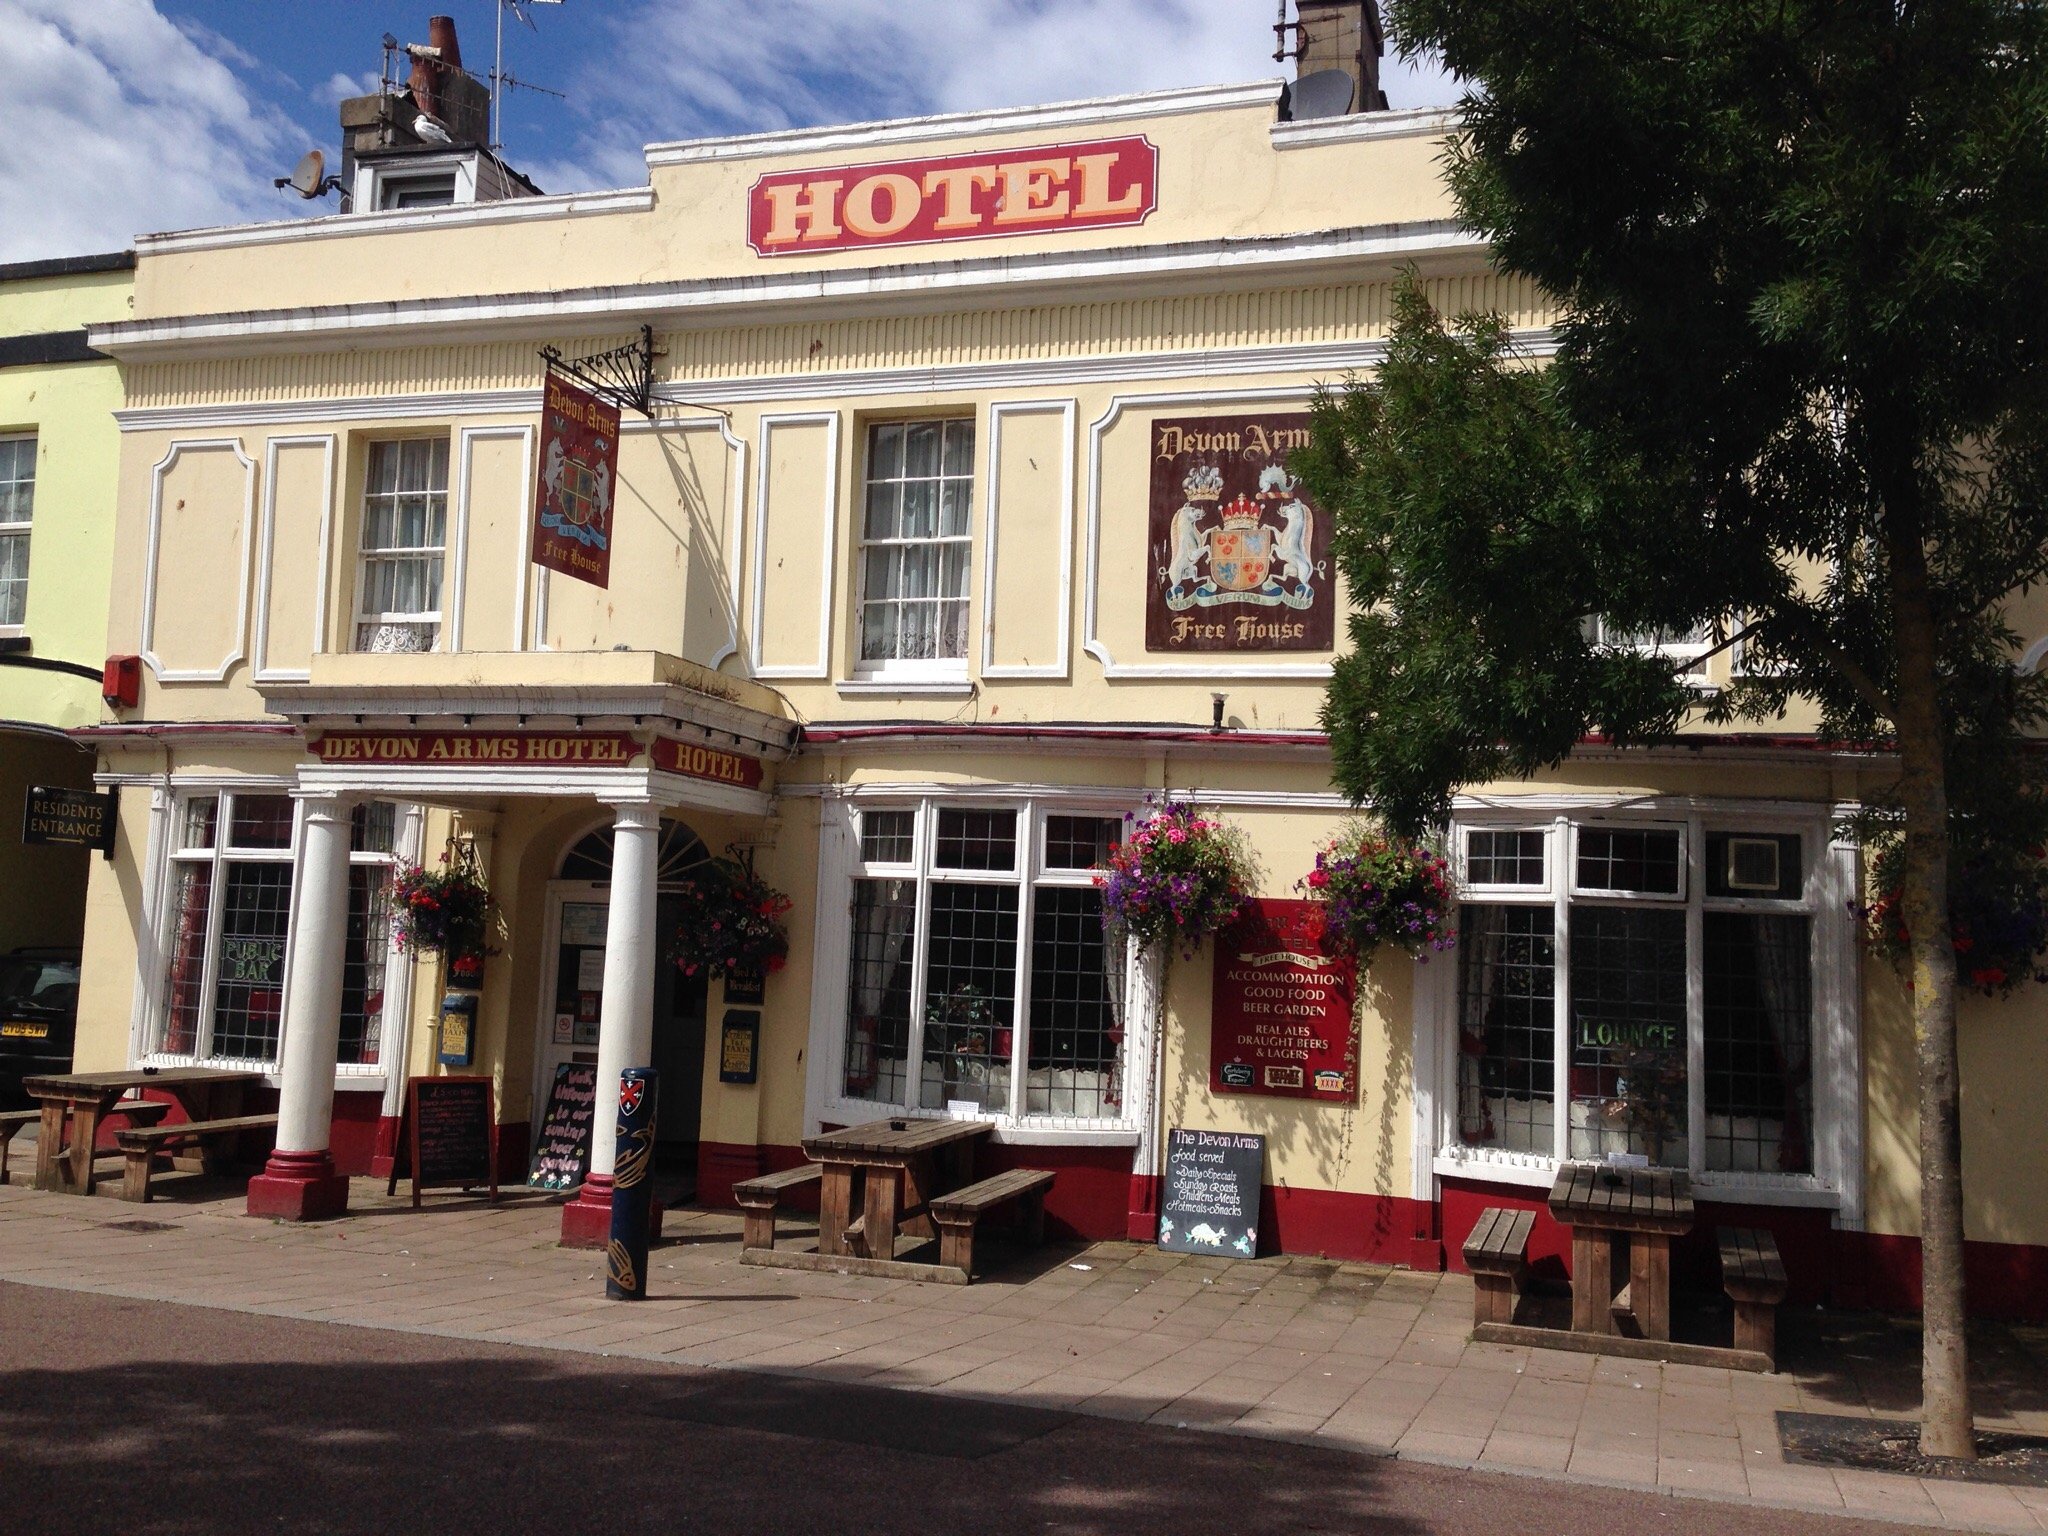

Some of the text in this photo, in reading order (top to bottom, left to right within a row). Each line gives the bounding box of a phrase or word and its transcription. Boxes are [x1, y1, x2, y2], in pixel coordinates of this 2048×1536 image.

[763, 153, 1142, 245] HOTEL
[549, 383, 616, 438] Devon Arms
[1156, 424, 1315, 461] Devon Arm
[542, 540, 602, 573] Free House
[1216, 593, 1261, 604] VERUM
[1170, 615, 1305, 643] Free House
[323, 738, 628, 761] DEVON ARMS HOTEL
[676, 743, 745, 782] HOTEL
[34, 800, 102, 820] RESIDENTS
[31, 818, 102, 837] ENTRANCE
[226, 941, 282, 960] PUBLIC
[1259, 952, 1312, 967] FREE HOUSE
[235, 960, 269, 980] BAR
[1227, 971, 1344, 986] ACCOMMODATION
[1244, 987, 1326, 1001] GOOD FOOD
[1243, 1002, 1327, 1017] BEER GARDEN
[1256, 1024, 1310, 1037] REAL ALES
[1237, 1035, 1329, 1049] DRAUGHT BEERS
[1256, 1048, 1309, 1060] & LAGERS
[1321, 1078, 1339, 1089] XXXX
[557, 1104, 592, 1120] to our
[545, 1121, 587, 1142] suntrap
[1175, 1130, 1259, 1149] The Devon Arms
[550, 1140, 575, 1154] beer
[540, 1154, 579, 1175] garden
[1199, 1151, 1224, 1163] served
[1176, 1164, 1237, 1181] Daily Specials
[1173, 1178, 1239, 1193] Sunday Roasts
[1179, 1188, 1241, 1205] Childrens Meals
